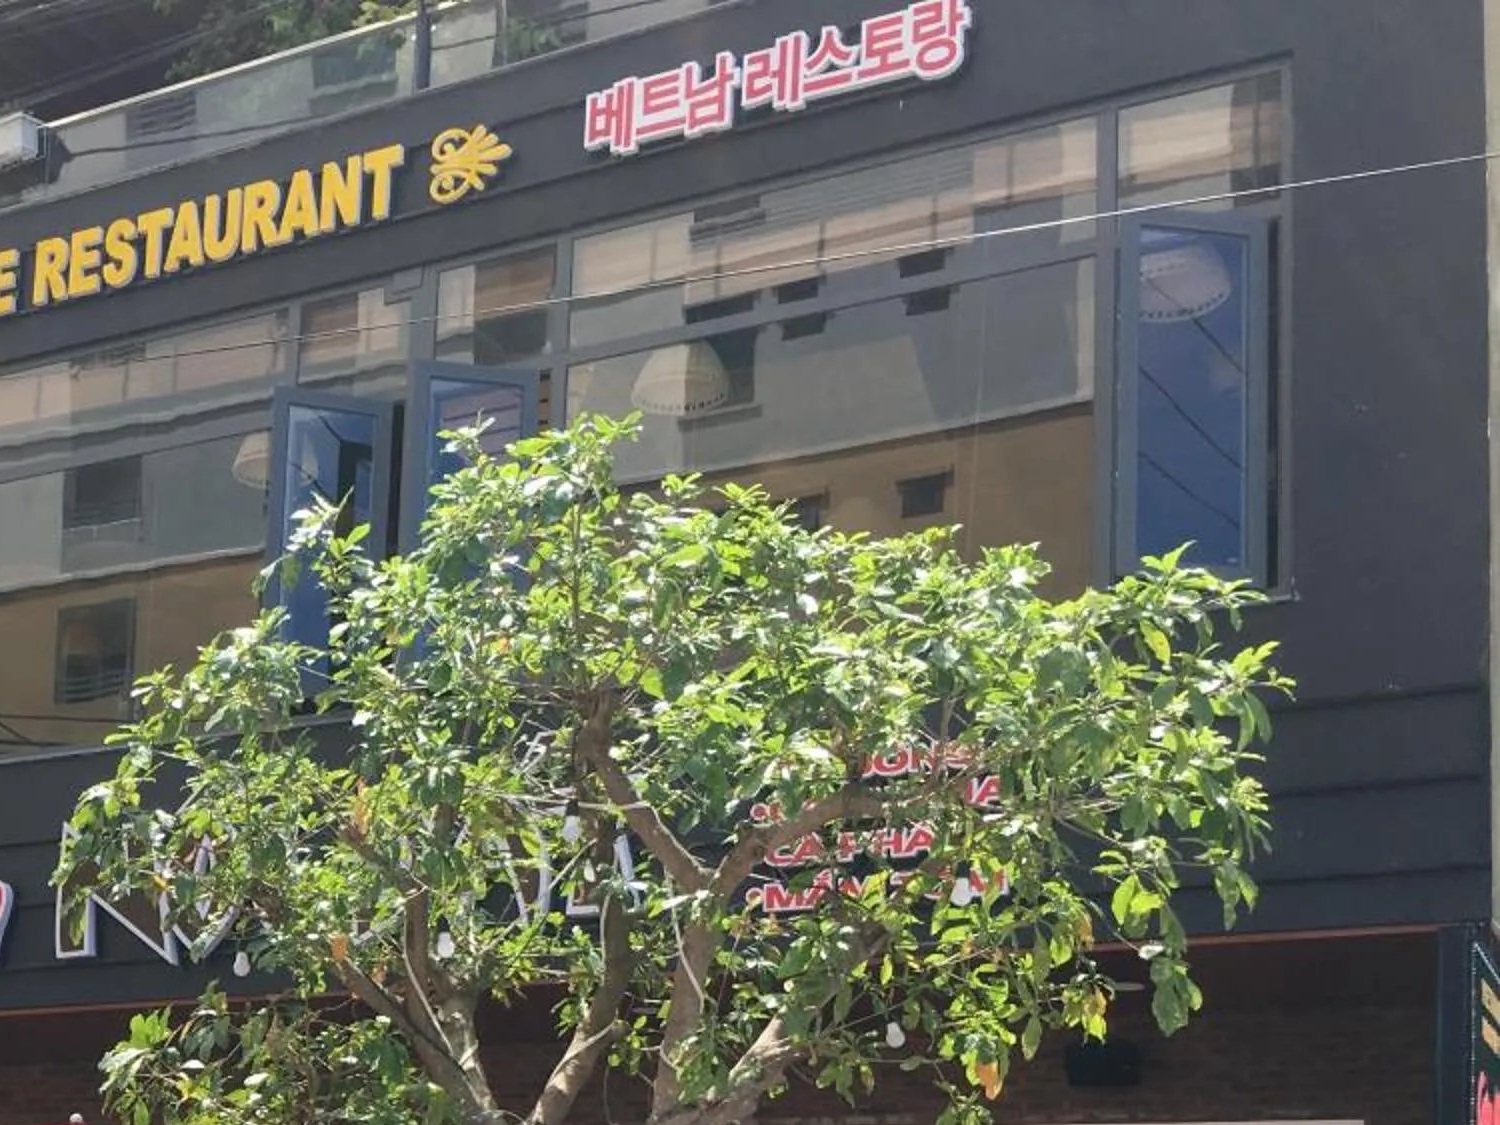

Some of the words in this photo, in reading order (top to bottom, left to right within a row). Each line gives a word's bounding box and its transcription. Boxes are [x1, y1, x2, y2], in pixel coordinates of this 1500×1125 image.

[584, 52, 741, 155] 베트남
[741, 0, 972, 110] 레스토랑
[32, 144, 404, 306] RESTAURANT
